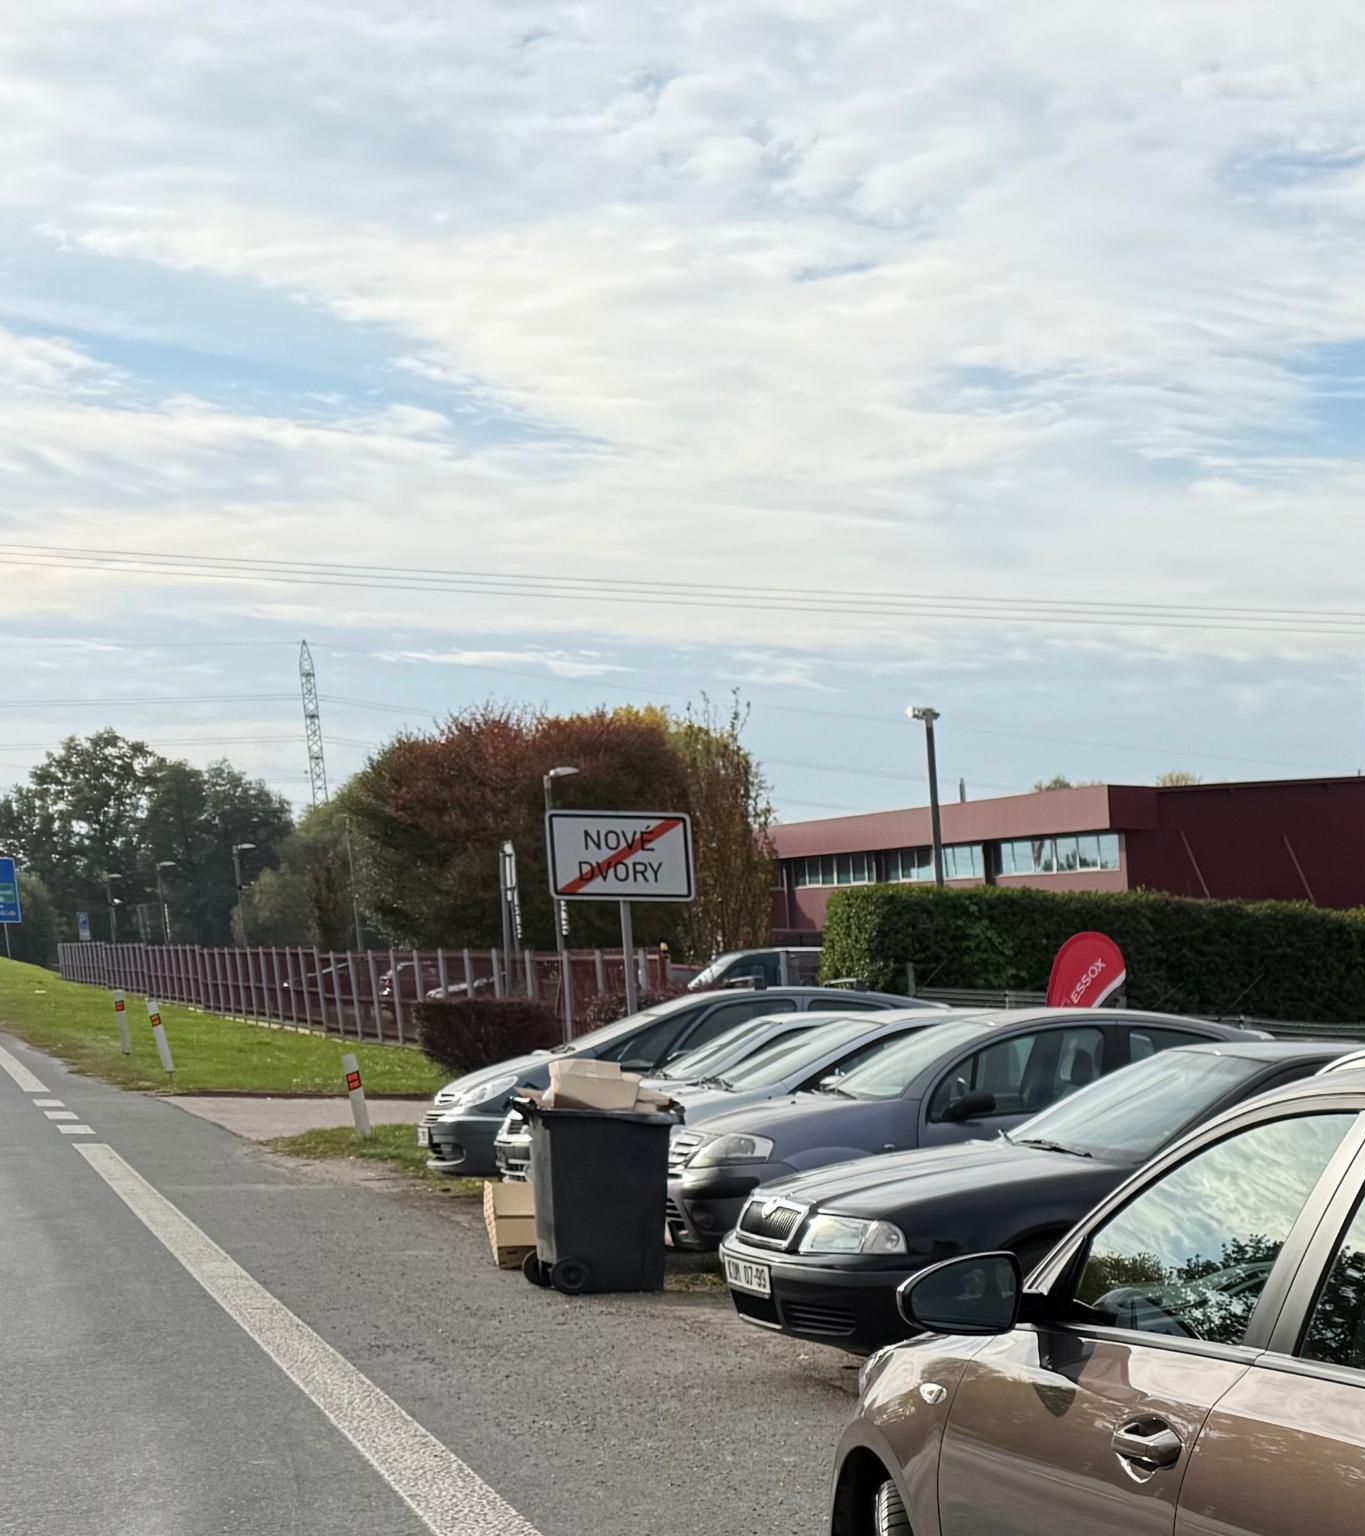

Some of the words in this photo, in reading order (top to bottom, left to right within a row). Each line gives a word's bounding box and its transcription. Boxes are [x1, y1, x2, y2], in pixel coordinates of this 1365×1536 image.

[584, 825, 656, 852] NOVÉ
[578, 861, 663, 883] DVORY
[1070, 957, 1107, 1004] ESSOX
